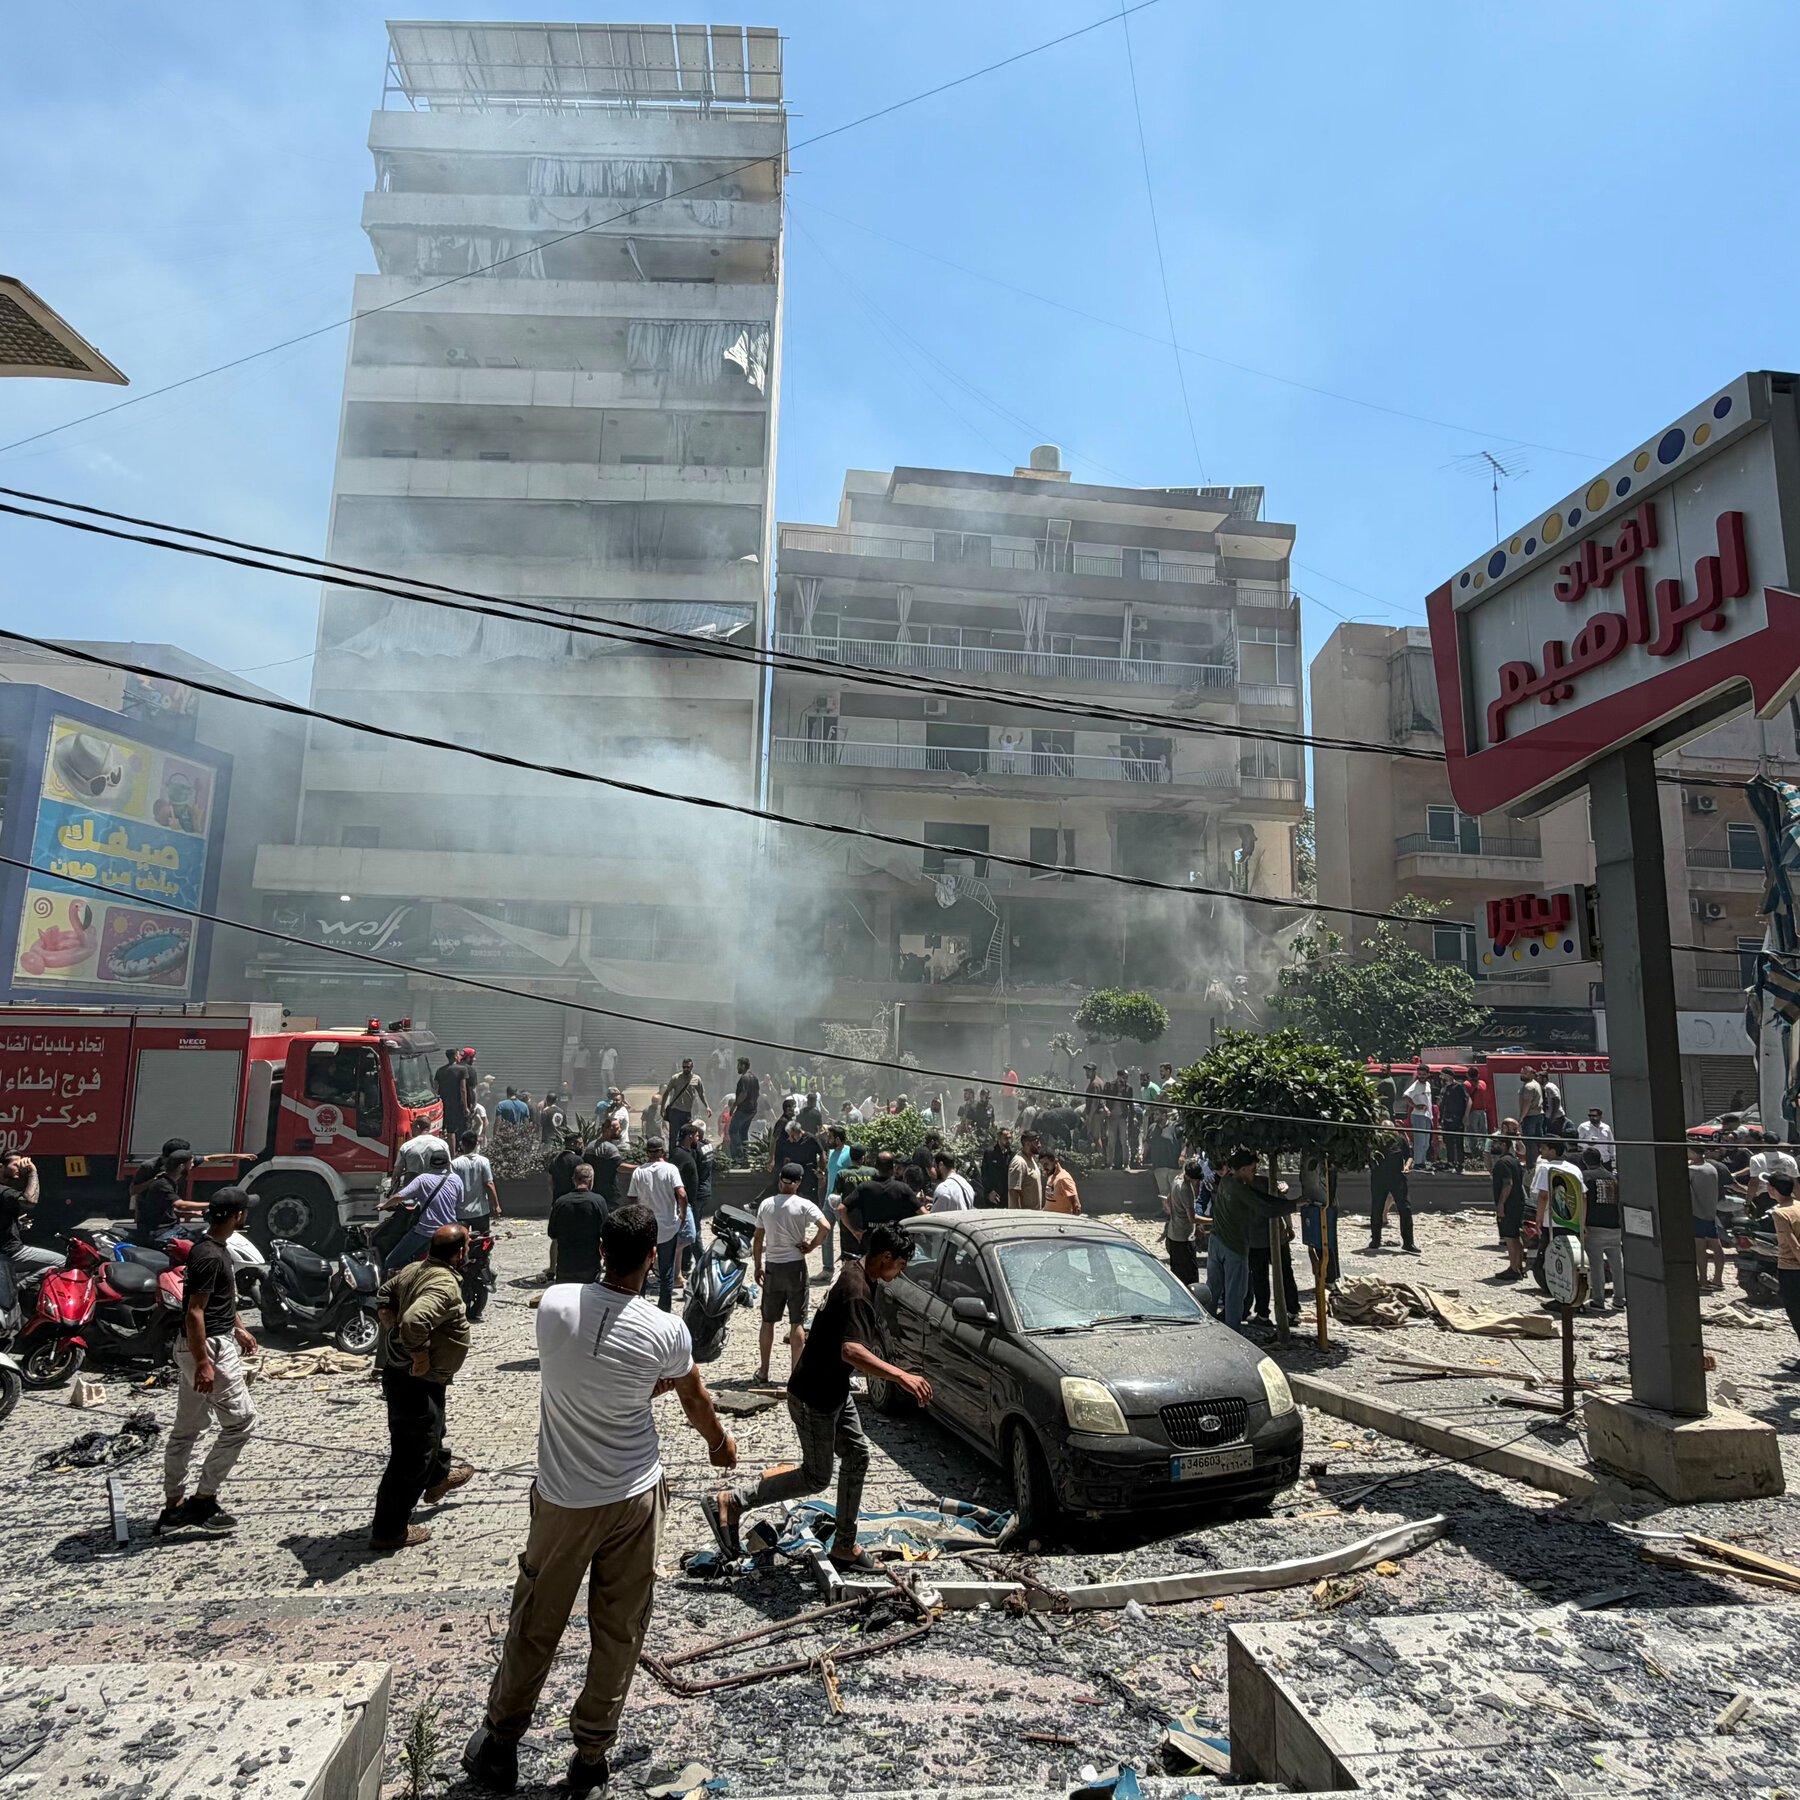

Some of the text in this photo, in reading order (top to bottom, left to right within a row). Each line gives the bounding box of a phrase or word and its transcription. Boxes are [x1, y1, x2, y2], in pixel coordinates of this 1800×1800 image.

[1554, 502, 1658, 602] افران
[1487, 511, 1749, 743] ابراهيم
[58, 819, 179, 872] صيفك
[32, 1035, 74, 1056] بلديات
[5, 1066, 58, 1097] إطفاء
[61, 1067, 101, 1099] فوج
[25, 1104, 98, 1129] مركز
[1187, 1455, 1221, 1470] 346603
